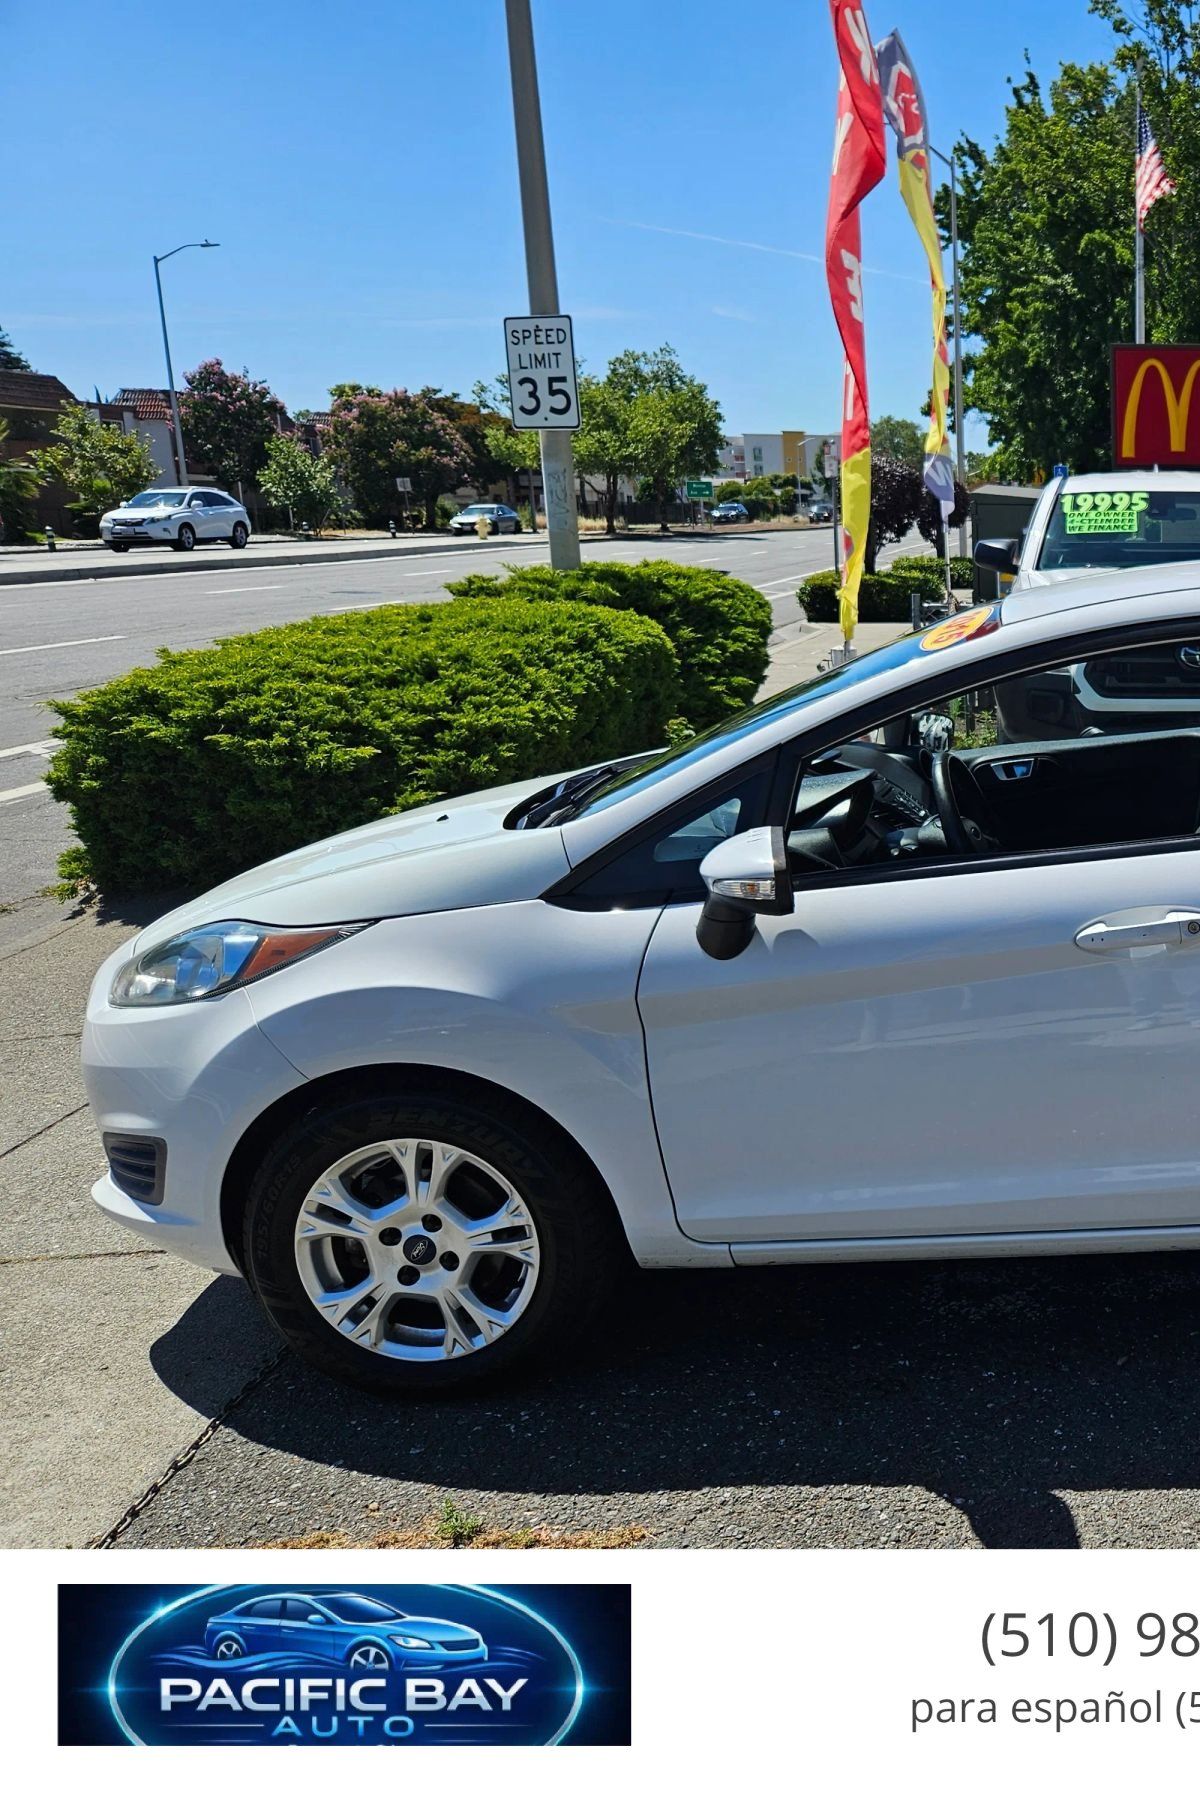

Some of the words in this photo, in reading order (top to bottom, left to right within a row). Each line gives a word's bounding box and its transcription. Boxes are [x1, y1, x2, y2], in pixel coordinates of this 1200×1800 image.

[511, 327, 567, 346] SPEED
[518, 352, 562, 370] LIMIT
[517, 376, 572, 416] 35
[1061, 492, 1149, 513] 19995
[1087, 524, 1135, 532] FINANCE
